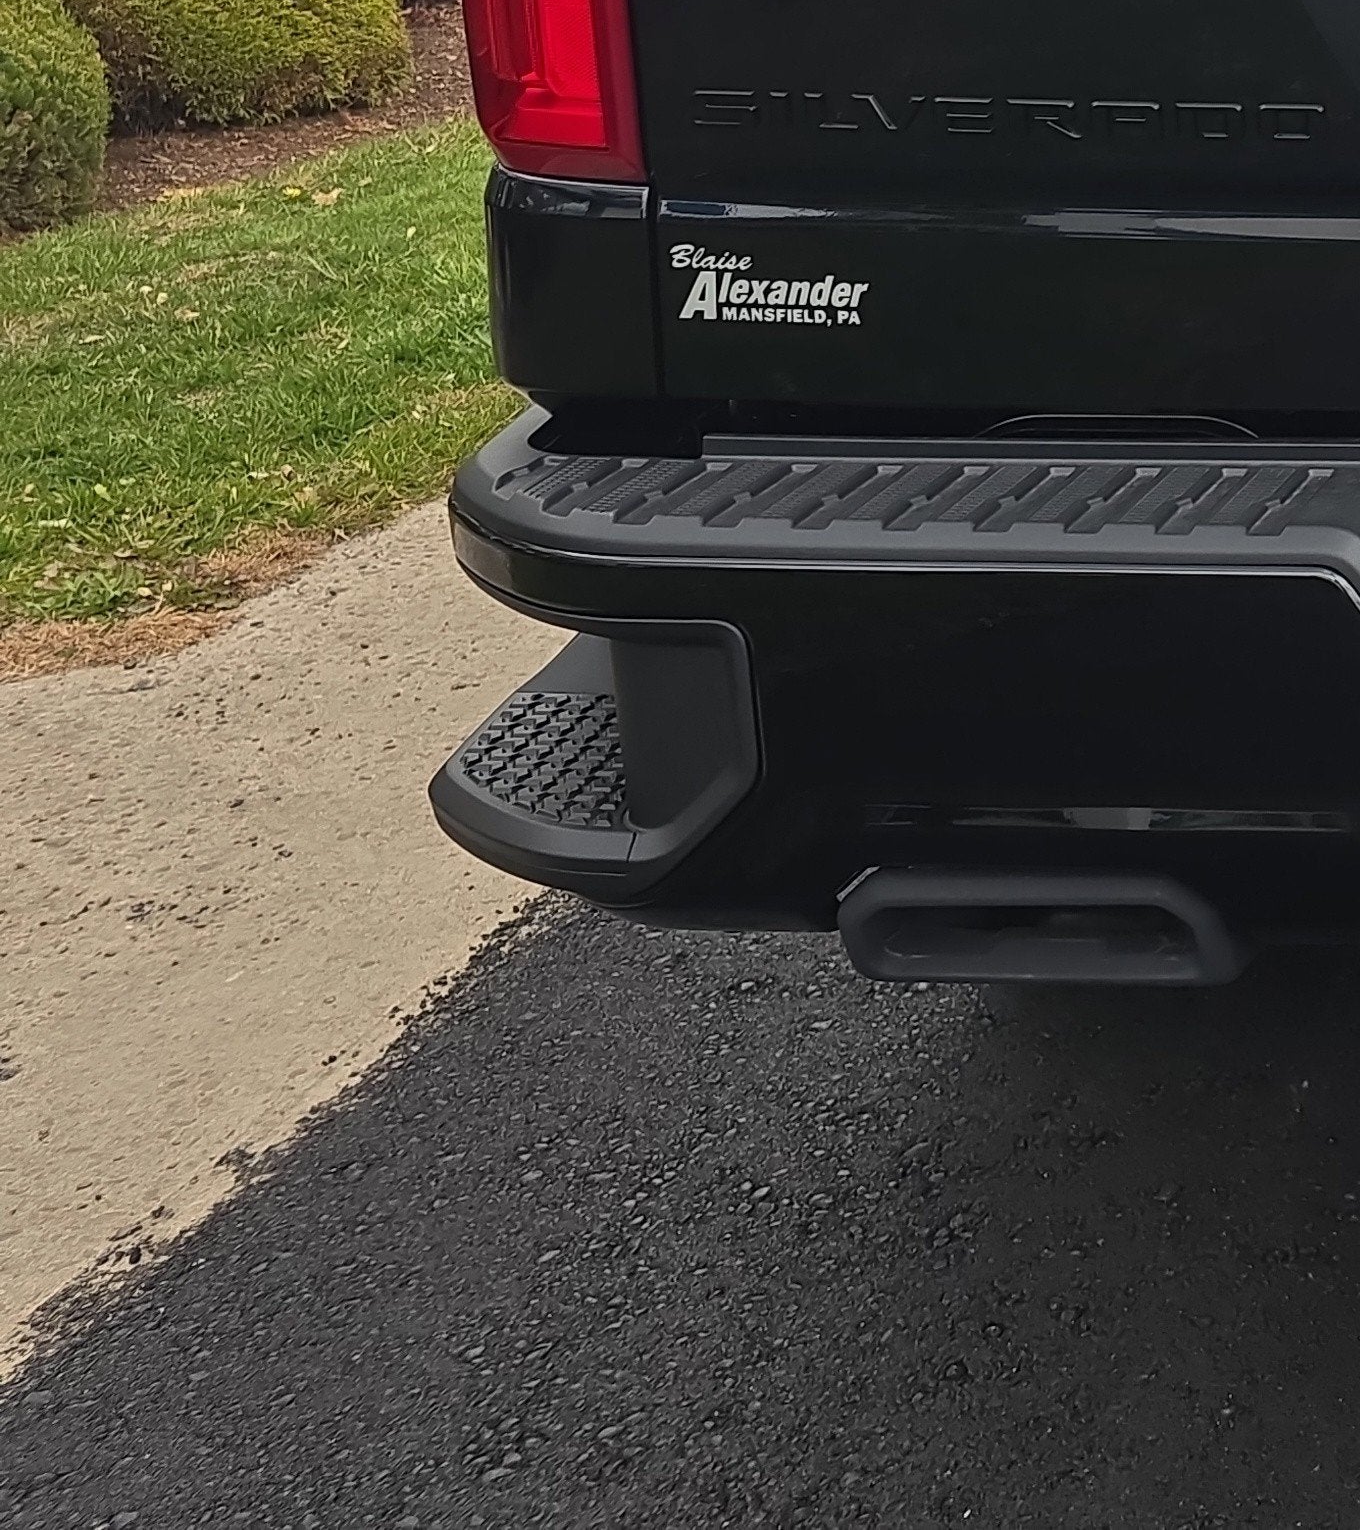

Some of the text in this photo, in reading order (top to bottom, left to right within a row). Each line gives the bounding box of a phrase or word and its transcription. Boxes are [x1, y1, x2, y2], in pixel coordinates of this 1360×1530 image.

[692, 87, 1328, 140] SILVERADO
[669, 243, 753, 271] Blaise
[678, 270, 870, 320] Alexander
[721, 306, 861, 327] MANSFIELD, PA
